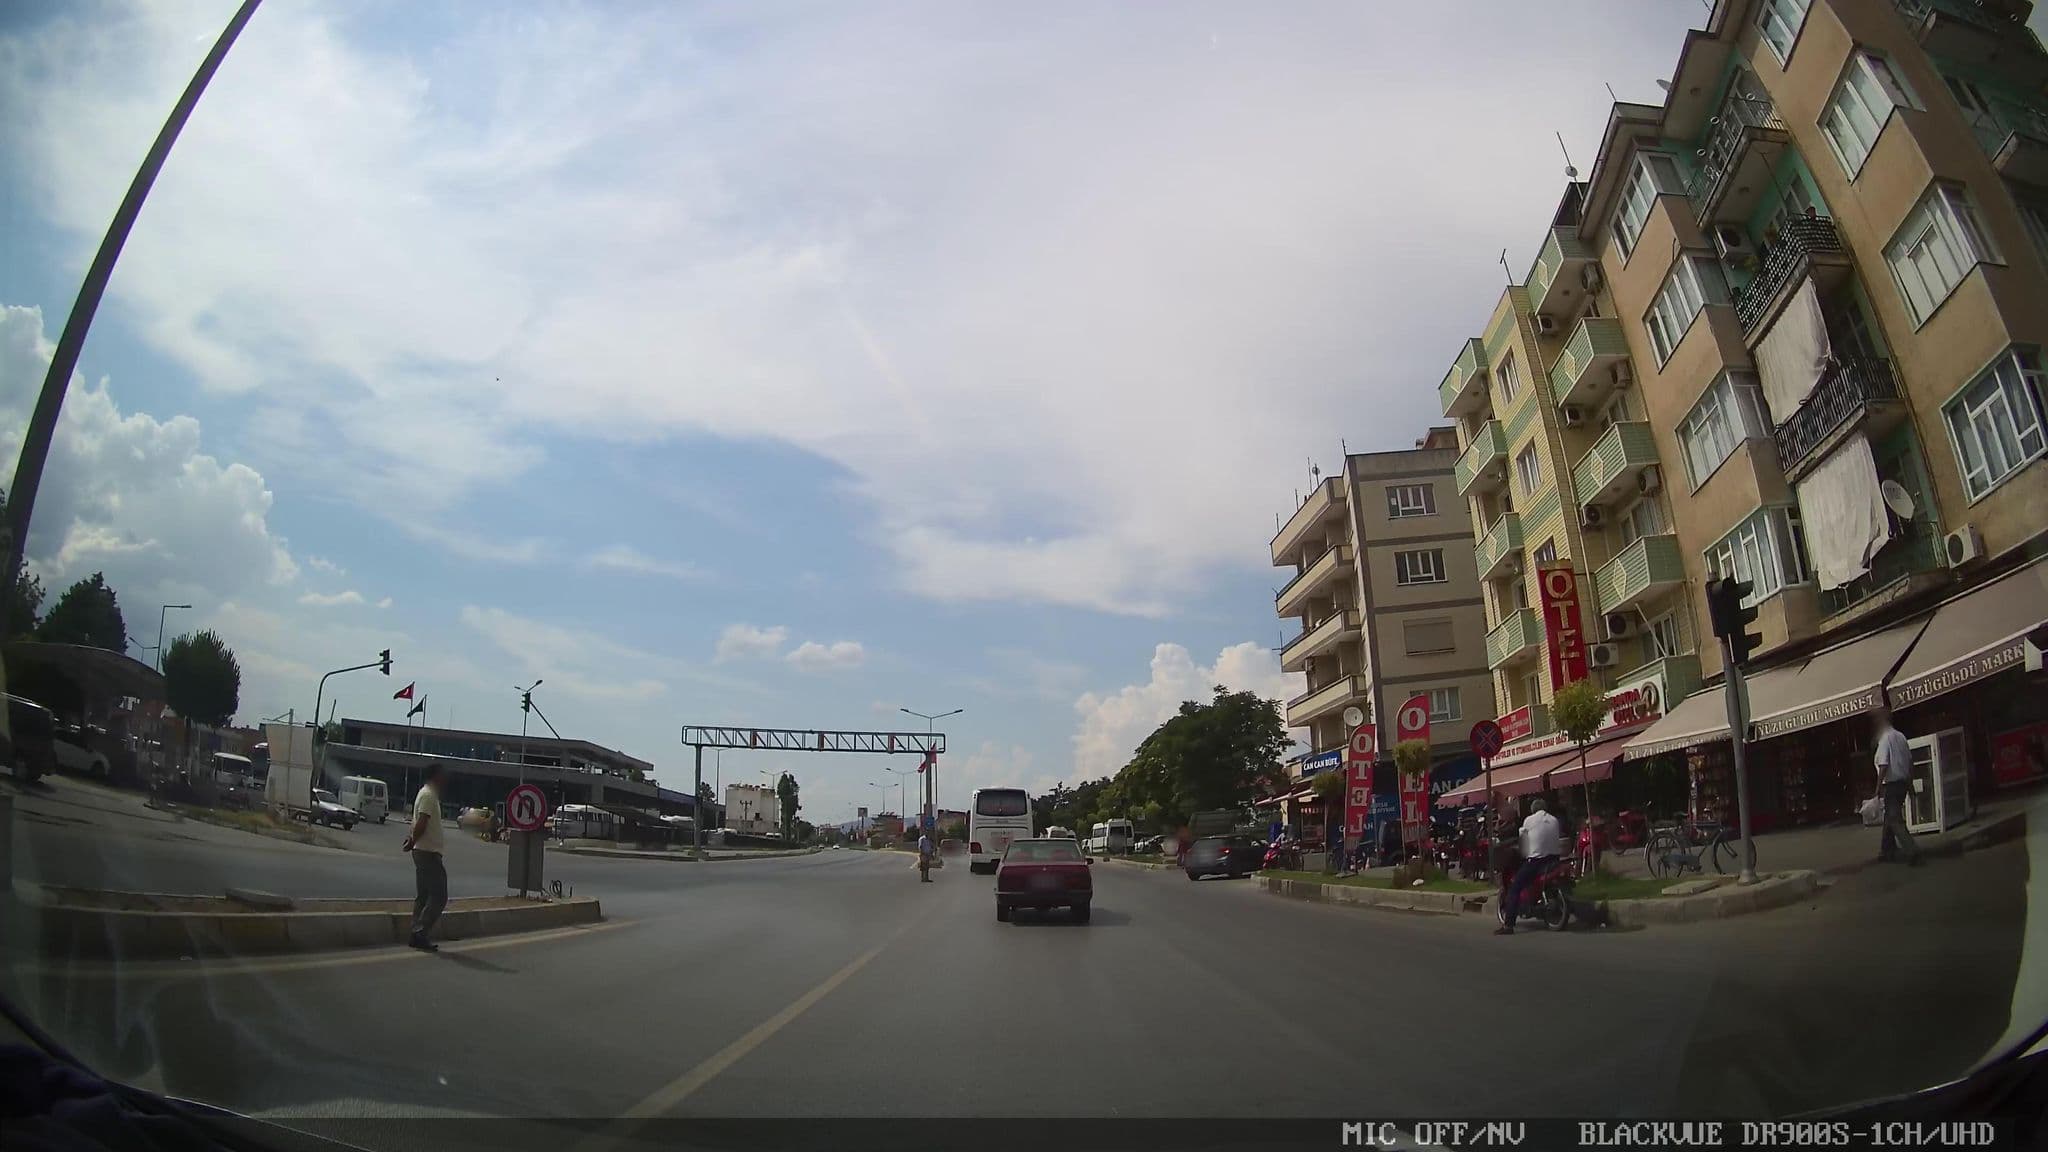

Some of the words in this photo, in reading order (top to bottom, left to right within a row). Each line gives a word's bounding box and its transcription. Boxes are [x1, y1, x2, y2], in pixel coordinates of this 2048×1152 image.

[1982, 643, 2024, 673] MARK
[1824, 694, 1873, 719] MARKET
[1401, 707, 1426, 823] OEL
